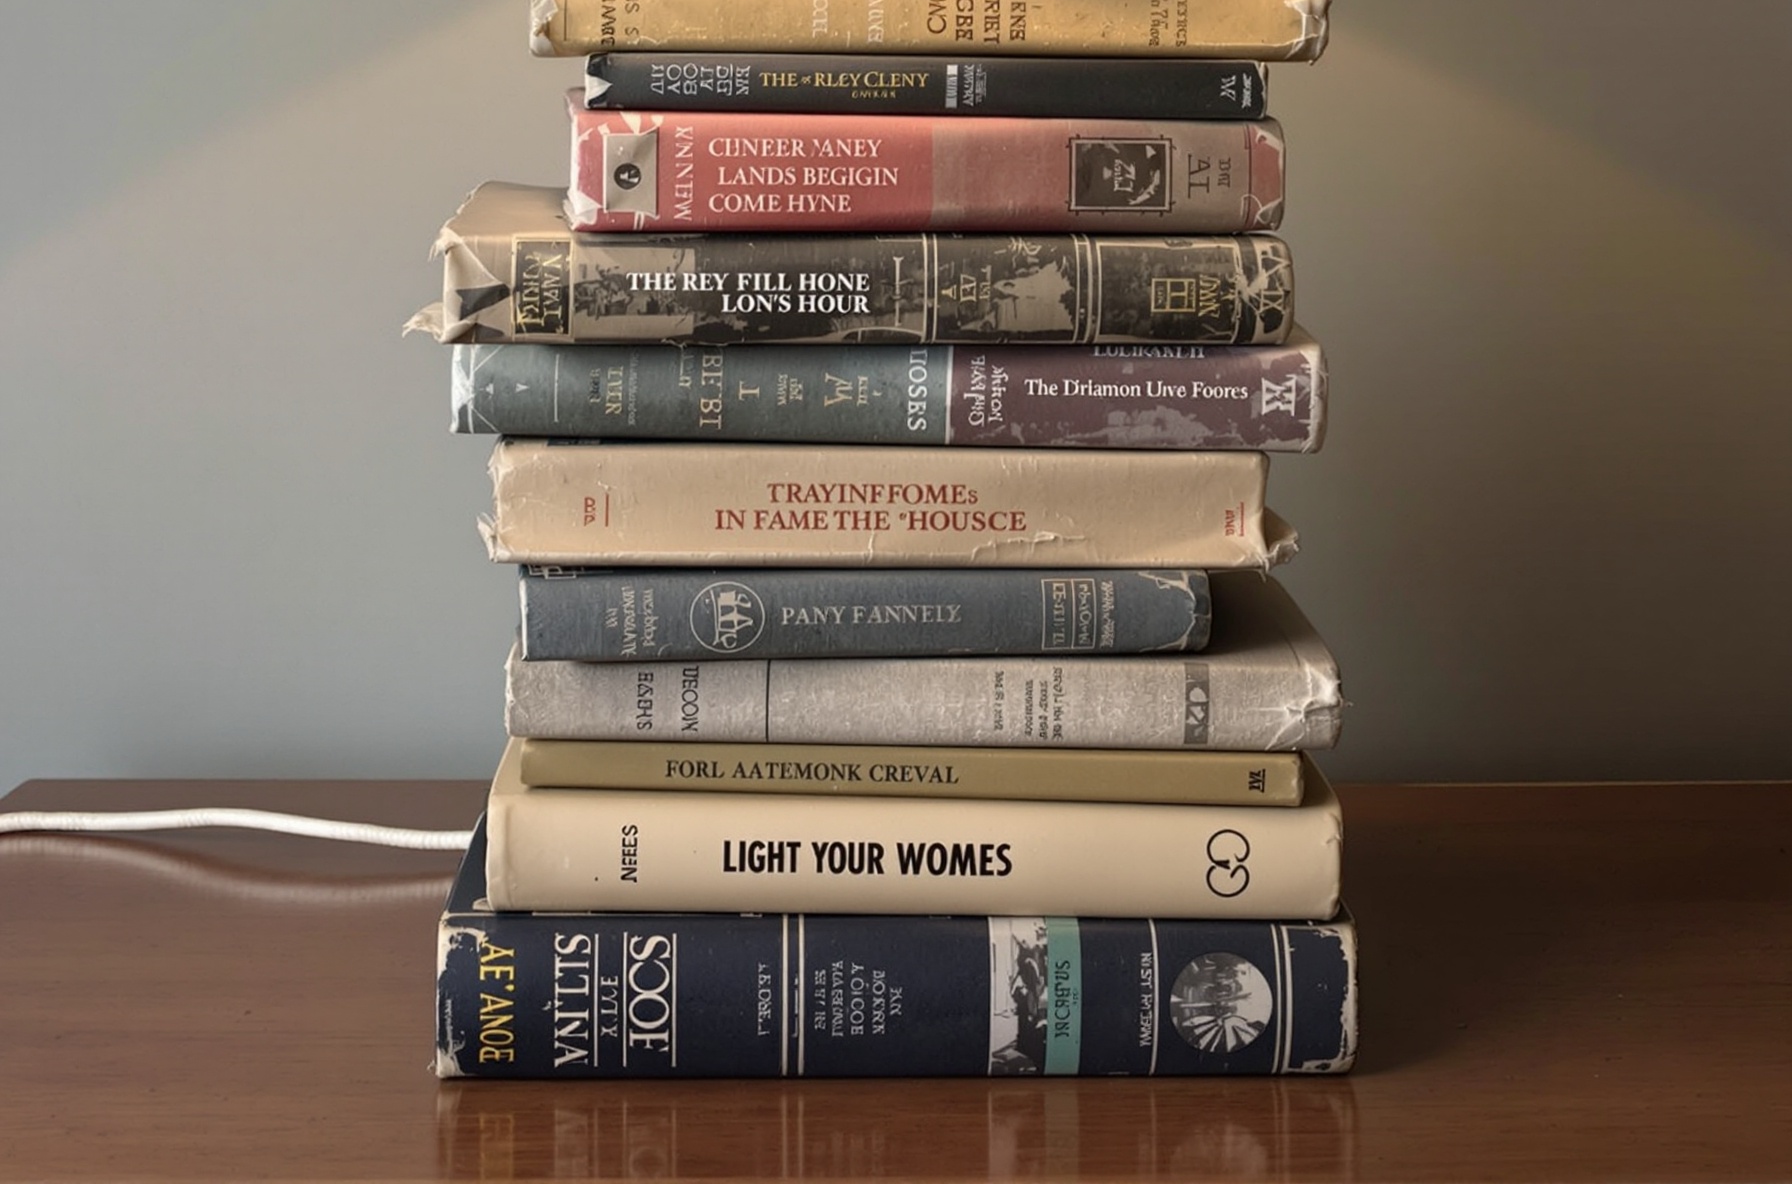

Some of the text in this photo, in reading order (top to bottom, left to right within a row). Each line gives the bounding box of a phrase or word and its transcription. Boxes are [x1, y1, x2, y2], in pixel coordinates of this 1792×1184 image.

[759, 72, 798, 87] THE
[864, 71, 929, 88] CLENY
[717, 166, 899, 187] LANDS BEGIGIN
[708, 192, 852, 213] COME HYNE
[626, 272, 870, 291] THE REY FILL HONE
[722, 294, 870, 314] LON'S HOUR
[1024, 378, 1058, 396] The
[1192, 381, 1249, 400] Foores
[715, 509, 746, 530] IN
[753, 509, 829, 530] FAME
[834, 509, 891, 531] THE
[782, 606, 847, 626] PANY
[665, 759, 959, 784] FORL AATEMONK CREVAL
[722, 839, 1013, 877] LIGHT YOUR WOMES
